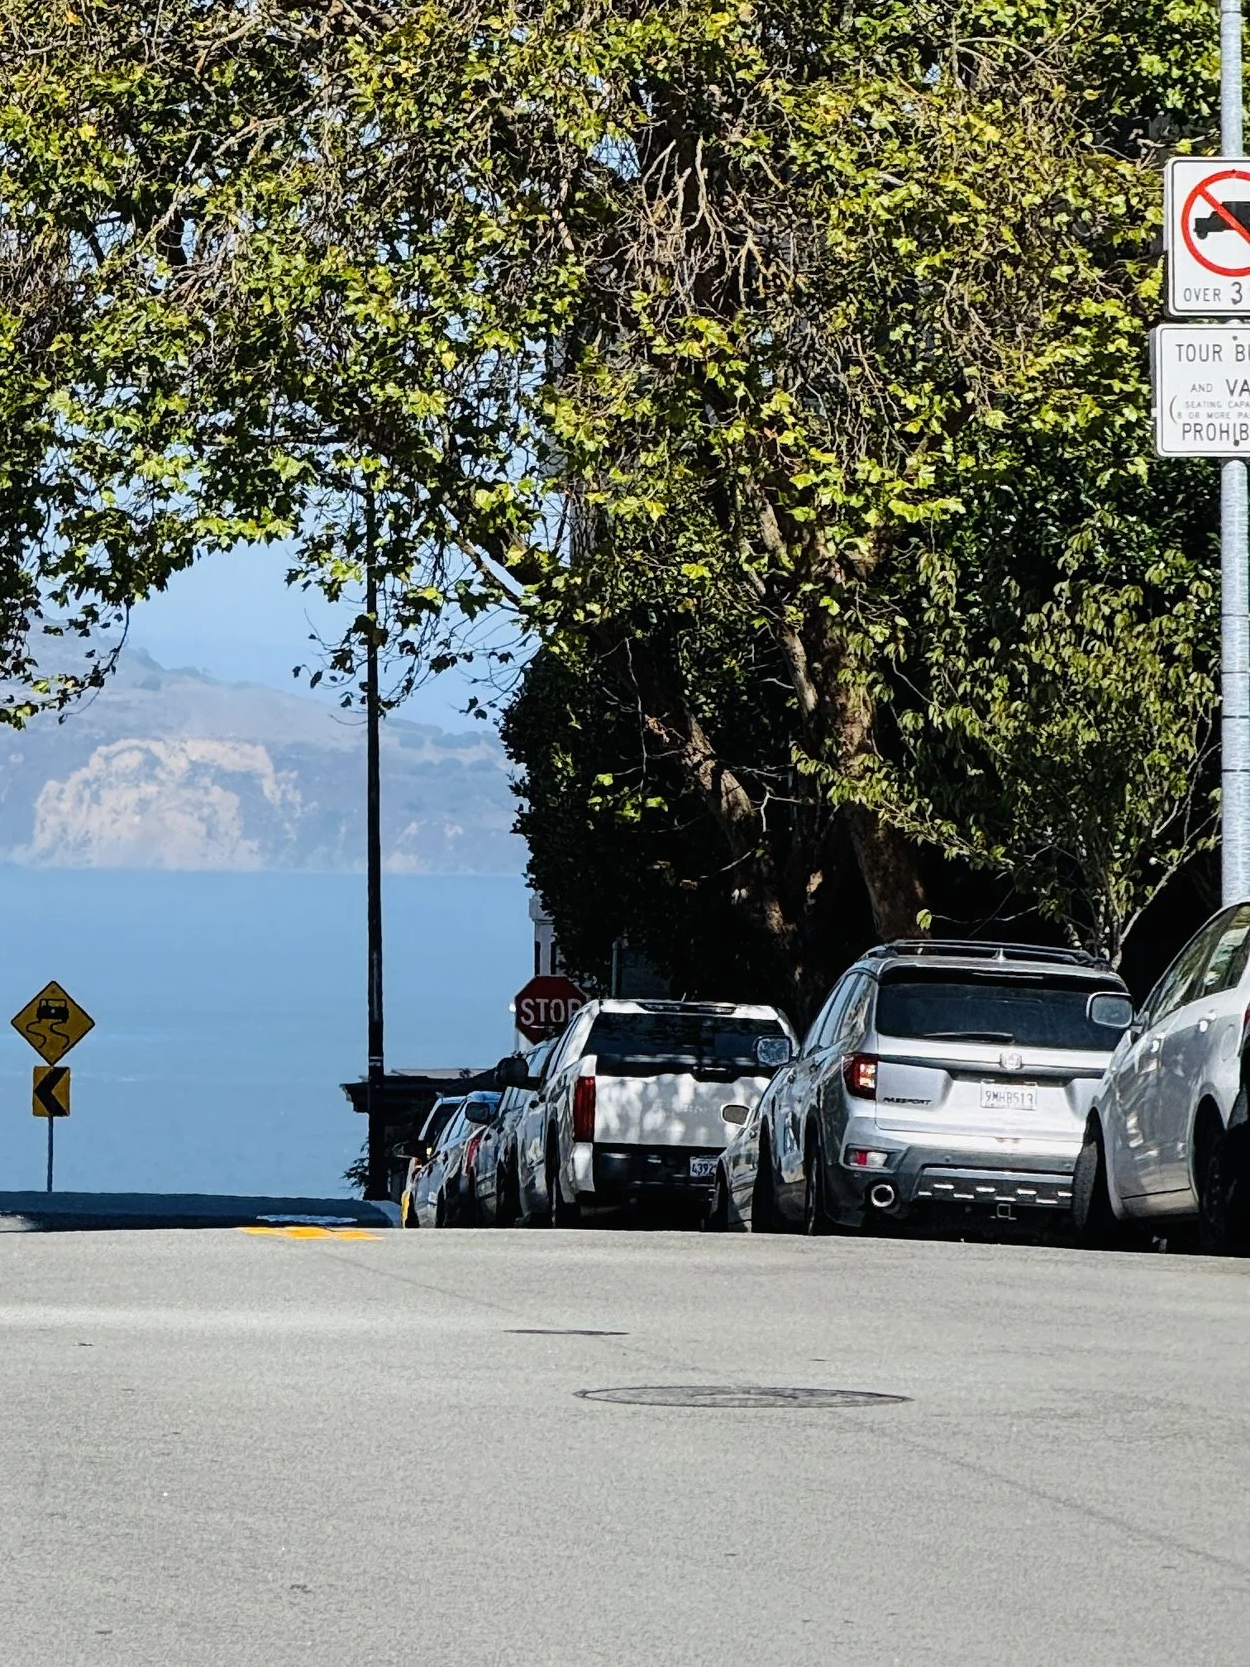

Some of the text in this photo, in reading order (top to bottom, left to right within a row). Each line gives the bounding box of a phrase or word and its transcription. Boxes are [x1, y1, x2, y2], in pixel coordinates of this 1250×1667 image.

[1183, 281, 1242, 305] OVER 3
[1175, 344, 1250, 362] TOUR B
[1190, 383, 1213, 392] AND
[1182, 423, 1249, 441] PROHIB
[520, 998, 583, 1025] STOP
